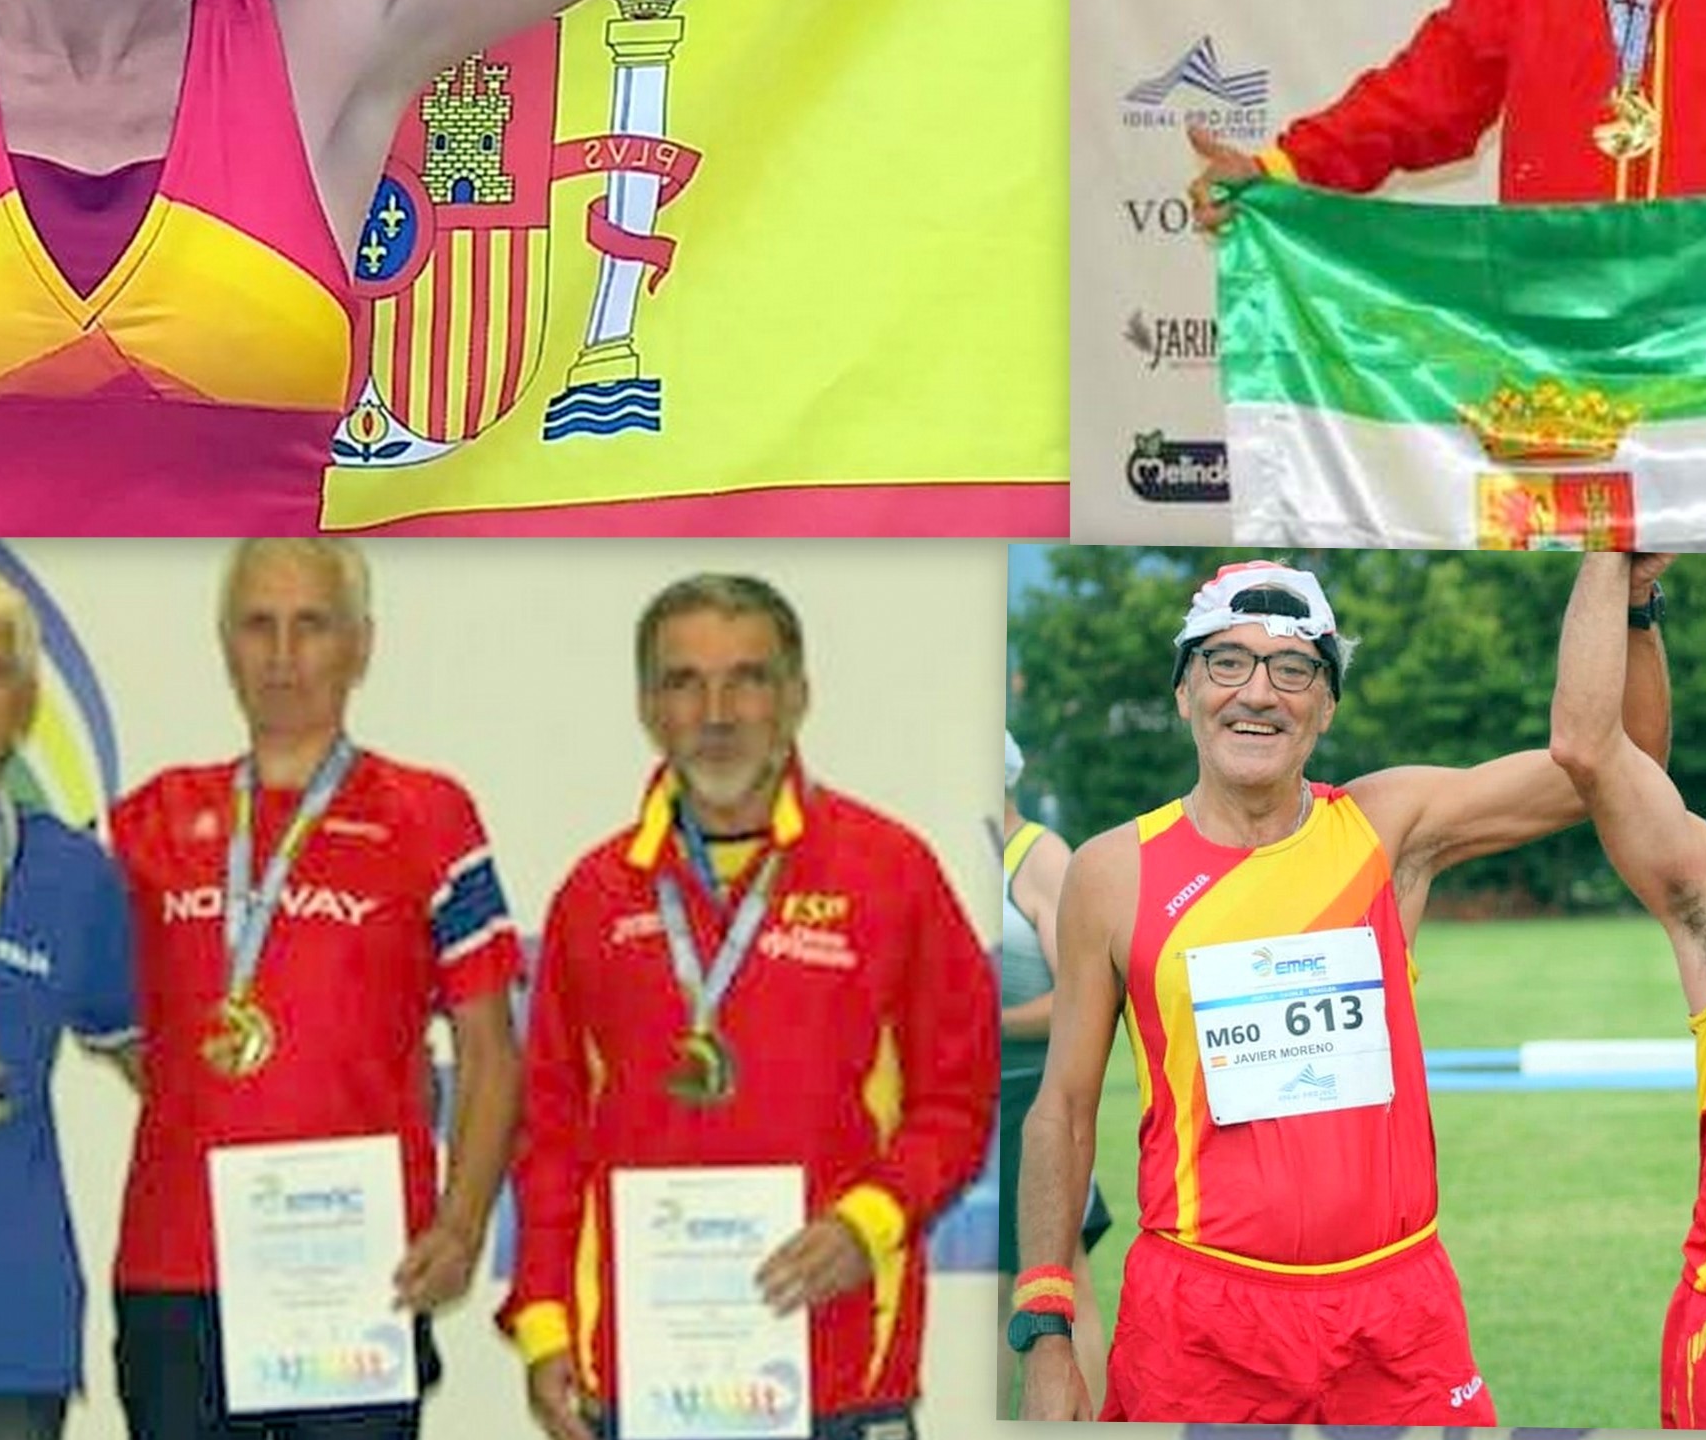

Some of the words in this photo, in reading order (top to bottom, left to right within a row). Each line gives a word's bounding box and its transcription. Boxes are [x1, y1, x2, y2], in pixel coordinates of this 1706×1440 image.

[1163, 872, 1212, 917] Joma
[1274, 955, 1327, 976] EMAC
[1205, 1022, 1261, 1049] M60
[1284, 994, 1364, 1037] 613
[1233, 1049, 1278, 1065] JAVIER
[1279, 1041, 1335, 1058] MORENO
